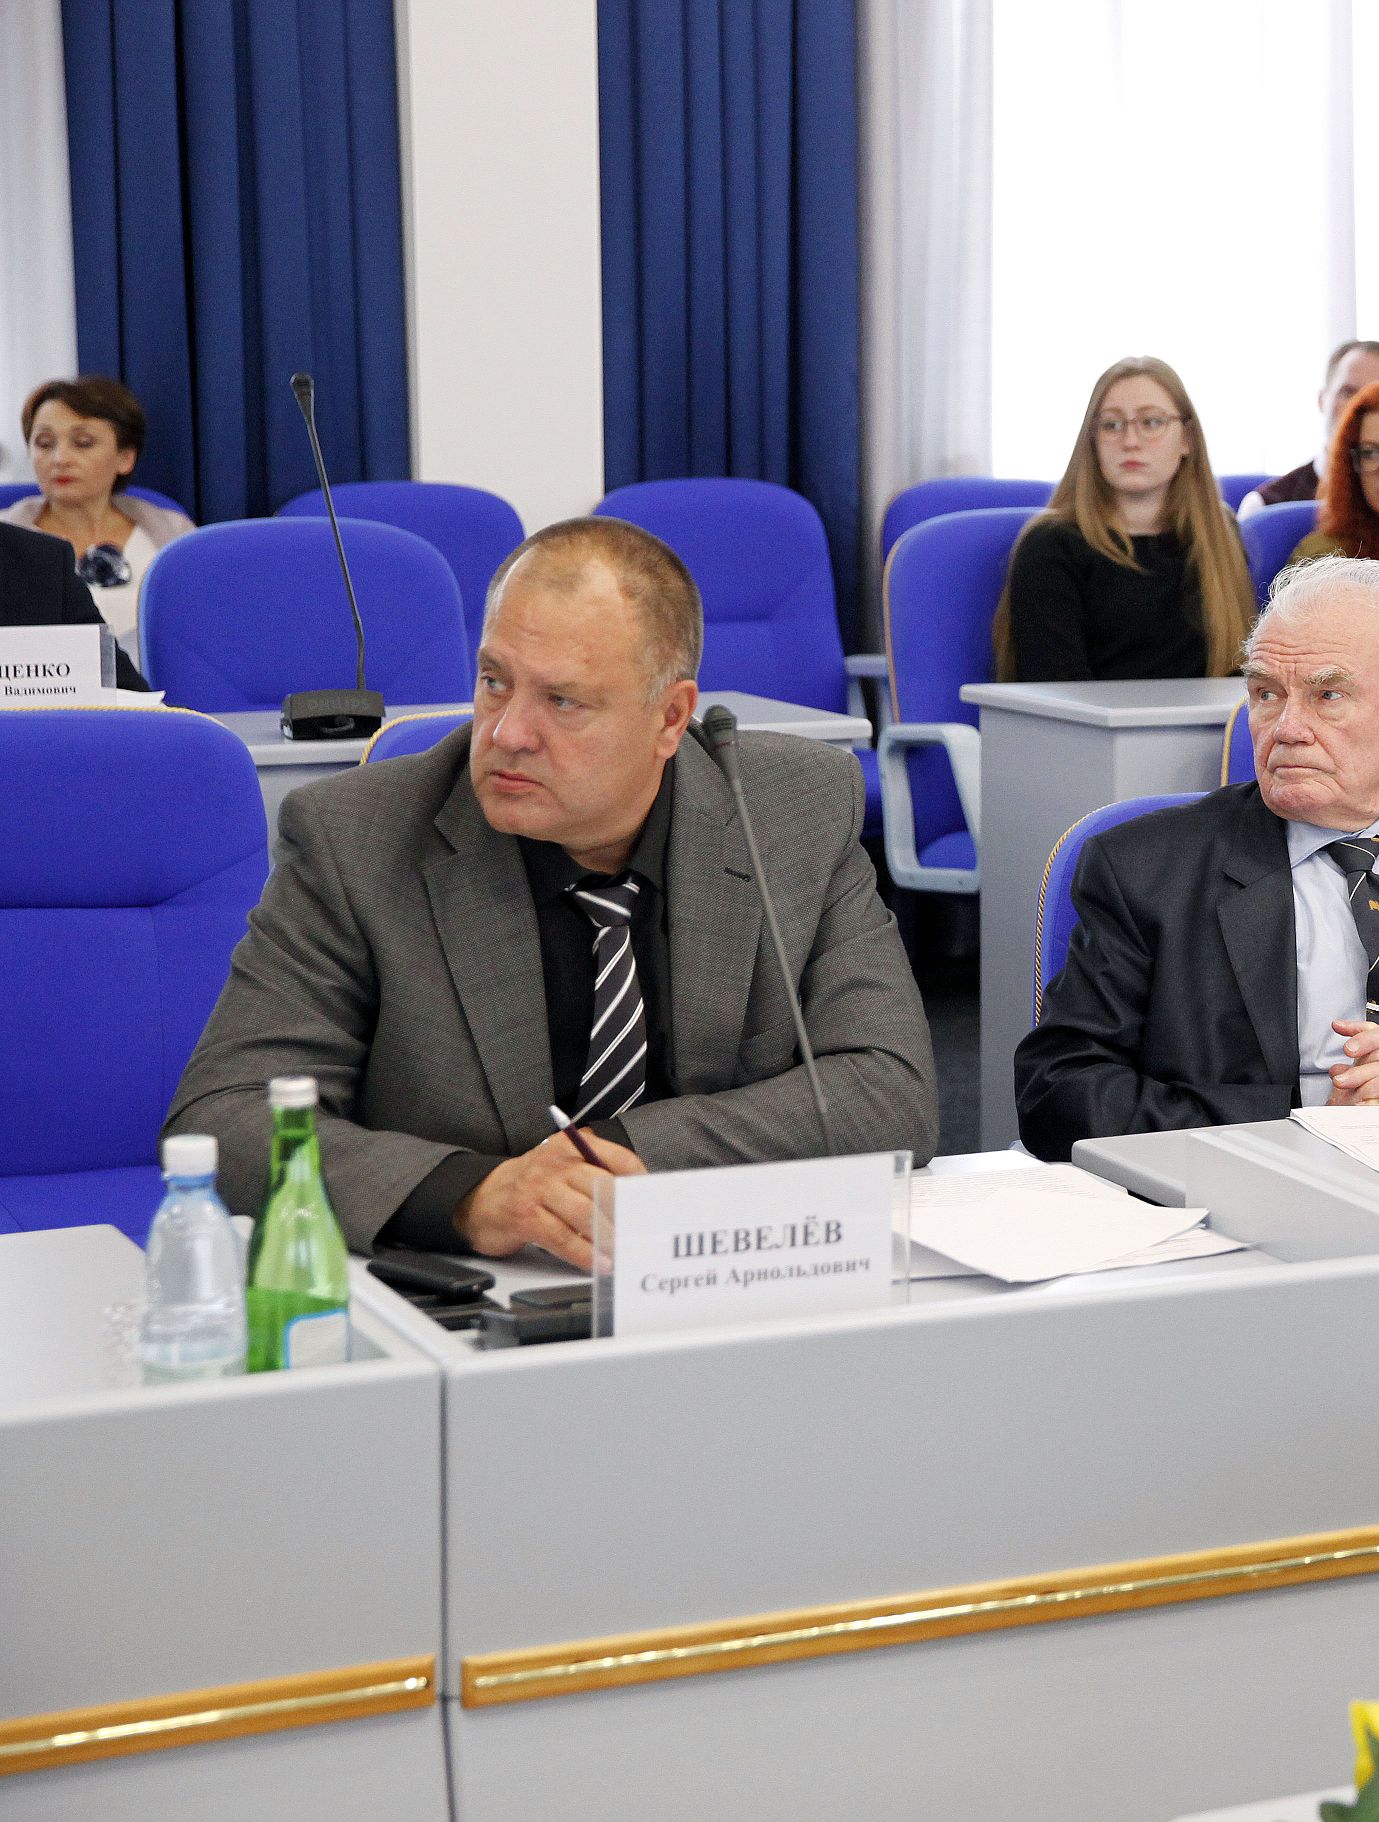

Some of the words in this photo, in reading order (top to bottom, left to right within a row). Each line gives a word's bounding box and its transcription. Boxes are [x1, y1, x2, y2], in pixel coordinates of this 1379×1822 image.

[4, 685, 77, 697] Вадимович
[672, 1215, 844, 1259] ШЕВЕЛЁВ
[640, 1270, 718, 1295] Сергей
[724, 1256, 870, 1288] Арнольдович
